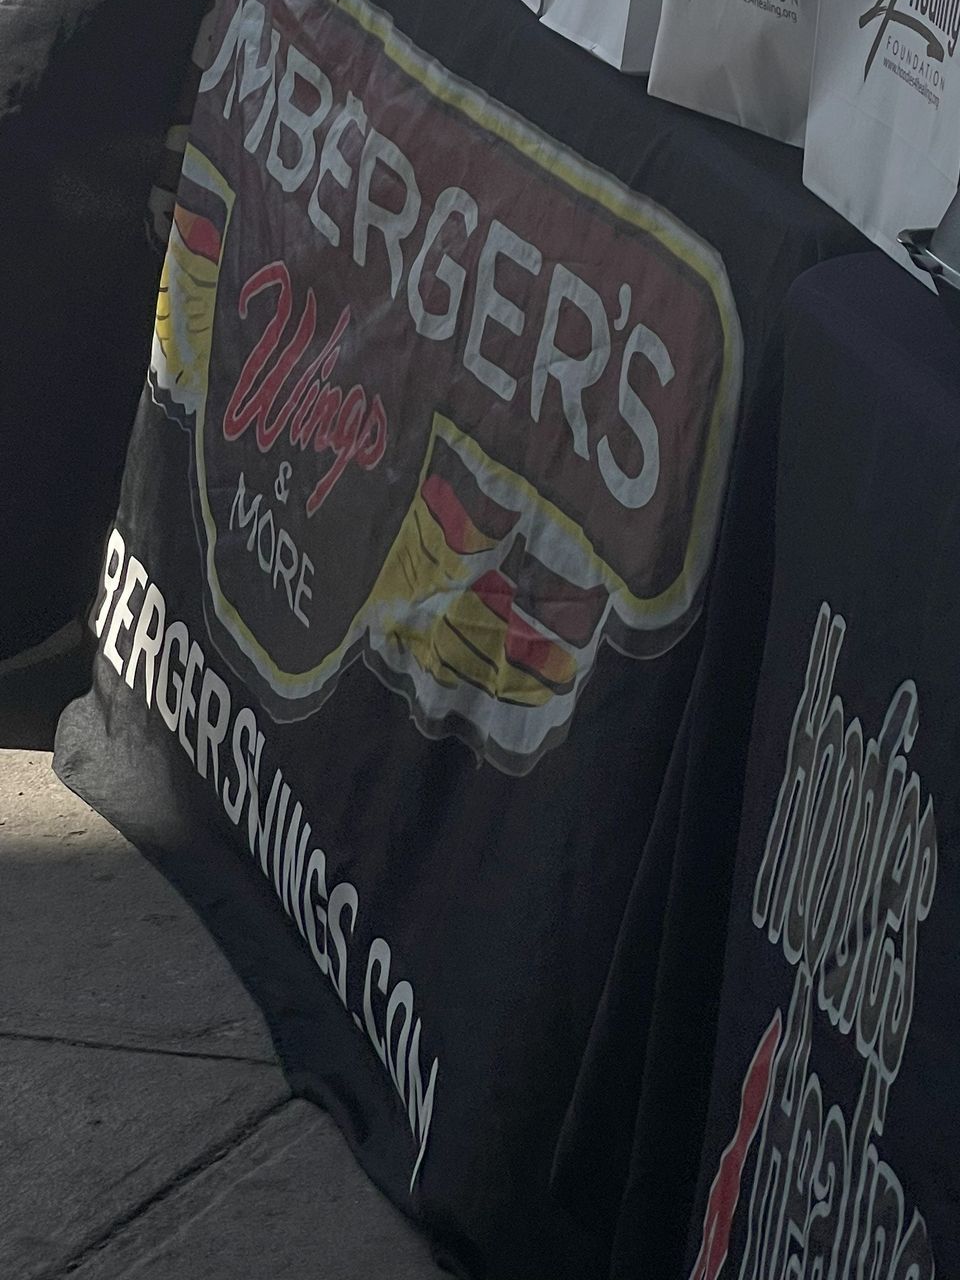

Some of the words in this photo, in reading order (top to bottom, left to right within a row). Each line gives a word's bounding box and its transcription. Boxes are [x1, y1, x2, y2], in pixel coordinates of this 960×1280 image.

[885, 34, 946, 91] FOUNDATION
[222, 260, 387, 519] Wings
[274, 461, 293, 504] &
[228, 471, 315, 628] MORE
